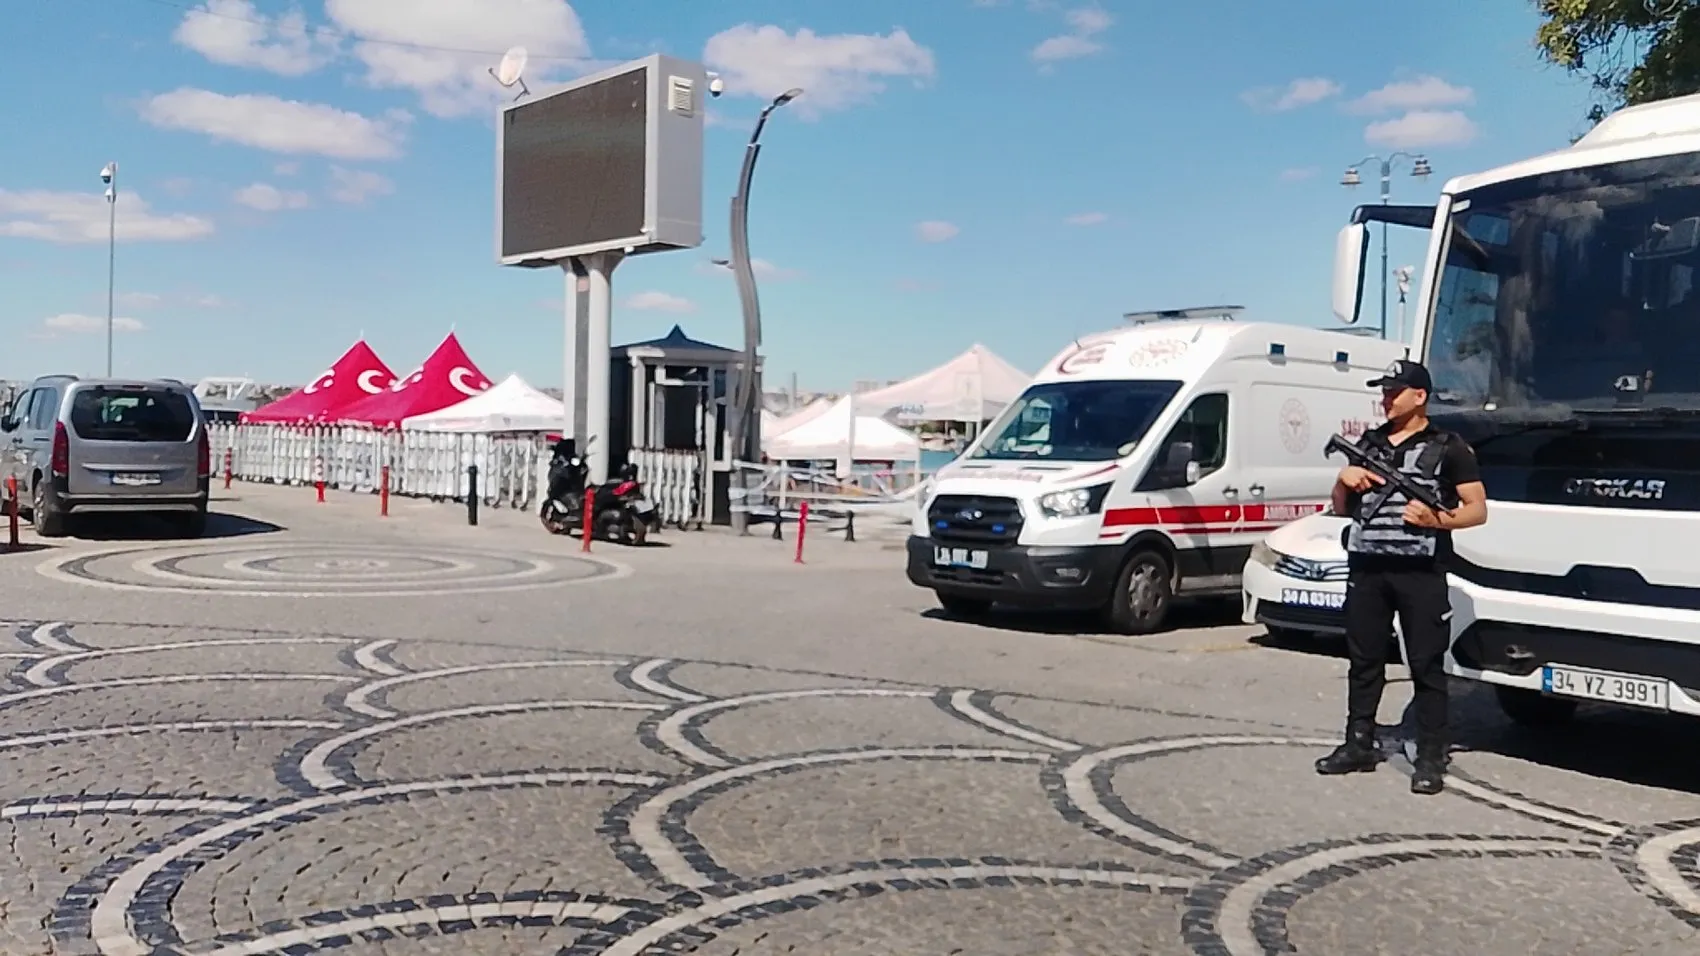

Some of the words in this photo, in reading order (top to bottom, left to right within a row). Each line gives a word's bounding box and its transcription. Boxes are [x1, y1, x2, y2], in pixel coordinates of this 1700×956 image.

[1299, 591, 1309, 605] A
[1554, 671, 1575, 692] 34
[1612, 679, 1659, 705] 3991
